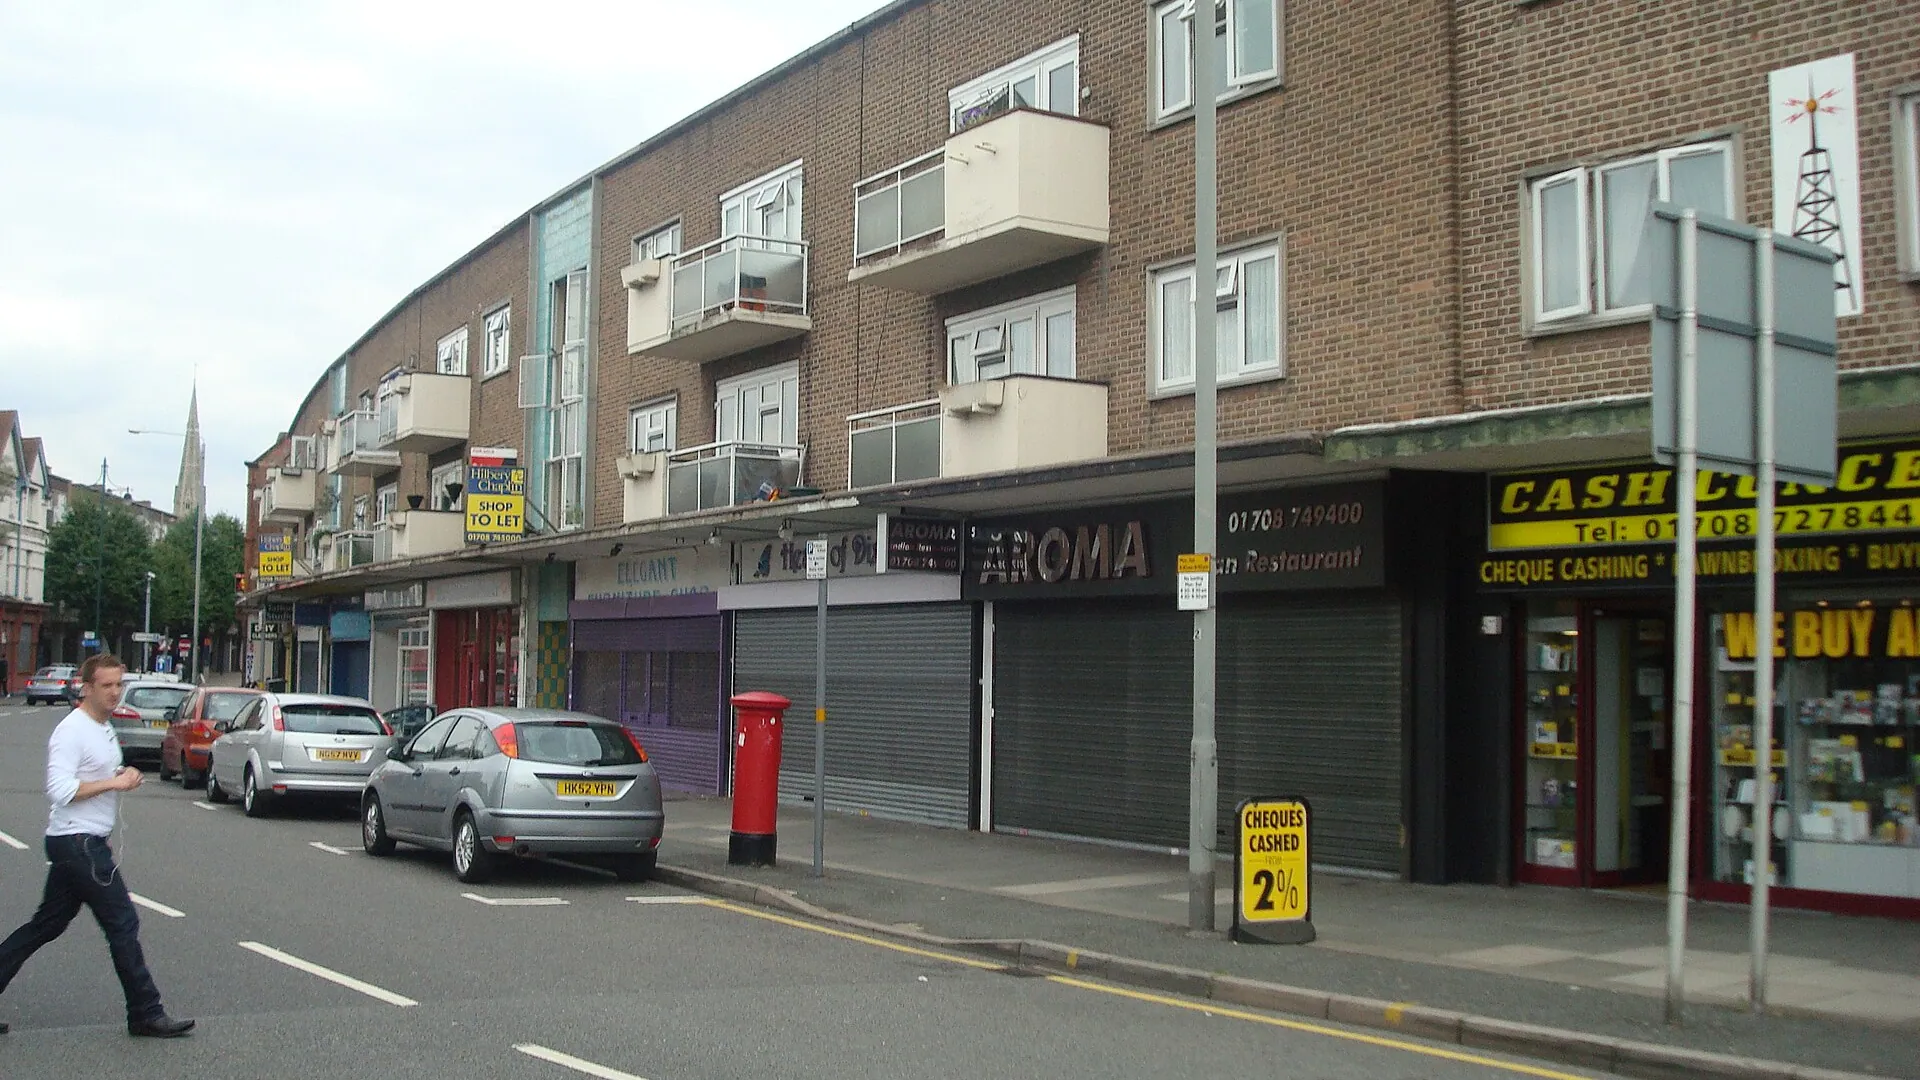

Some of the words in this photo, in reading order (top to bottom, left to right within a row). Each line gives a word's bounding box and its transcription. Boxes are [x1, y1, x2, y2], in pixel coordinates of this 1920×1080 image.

[478, 480, 523, 494] Chaplin
[1499, 470, 1672, 514] CASH
[470, 514, 492, 526] TO
[497, 515, 521, 527] LET
[479, 502, 513, 512] SHOP
[1228, 508, 1285, 533] 01708
[1291, 502, 1364, 528] 749400
[1575, 523, 1627, 543] Tel:
[1774, 504, 1914, 531] 727844
[830, 536, 848, 574] of
[979, 520, 1151, 584] AROMA
[1246, 545, 1363, 573] Restaurant
[262, 564, 273, 572] TO
[276, 564, 289, 572] LET
[618, 556, 677, 585] ELEGANT
[1480, 557, 1554, 586] CHEQUE
[1559, 553, 1648, 582] CASHING
[1794, 609, 1875, 657] BUY
[564, 783, 592, 795] HK52
[594, 783, 614, 794] YPN
[1245, 810, 1304, 829] CHEQUES
[1249, 834, 1299, 852] CASHED
[1253, 868, 1299, 911] 2%
